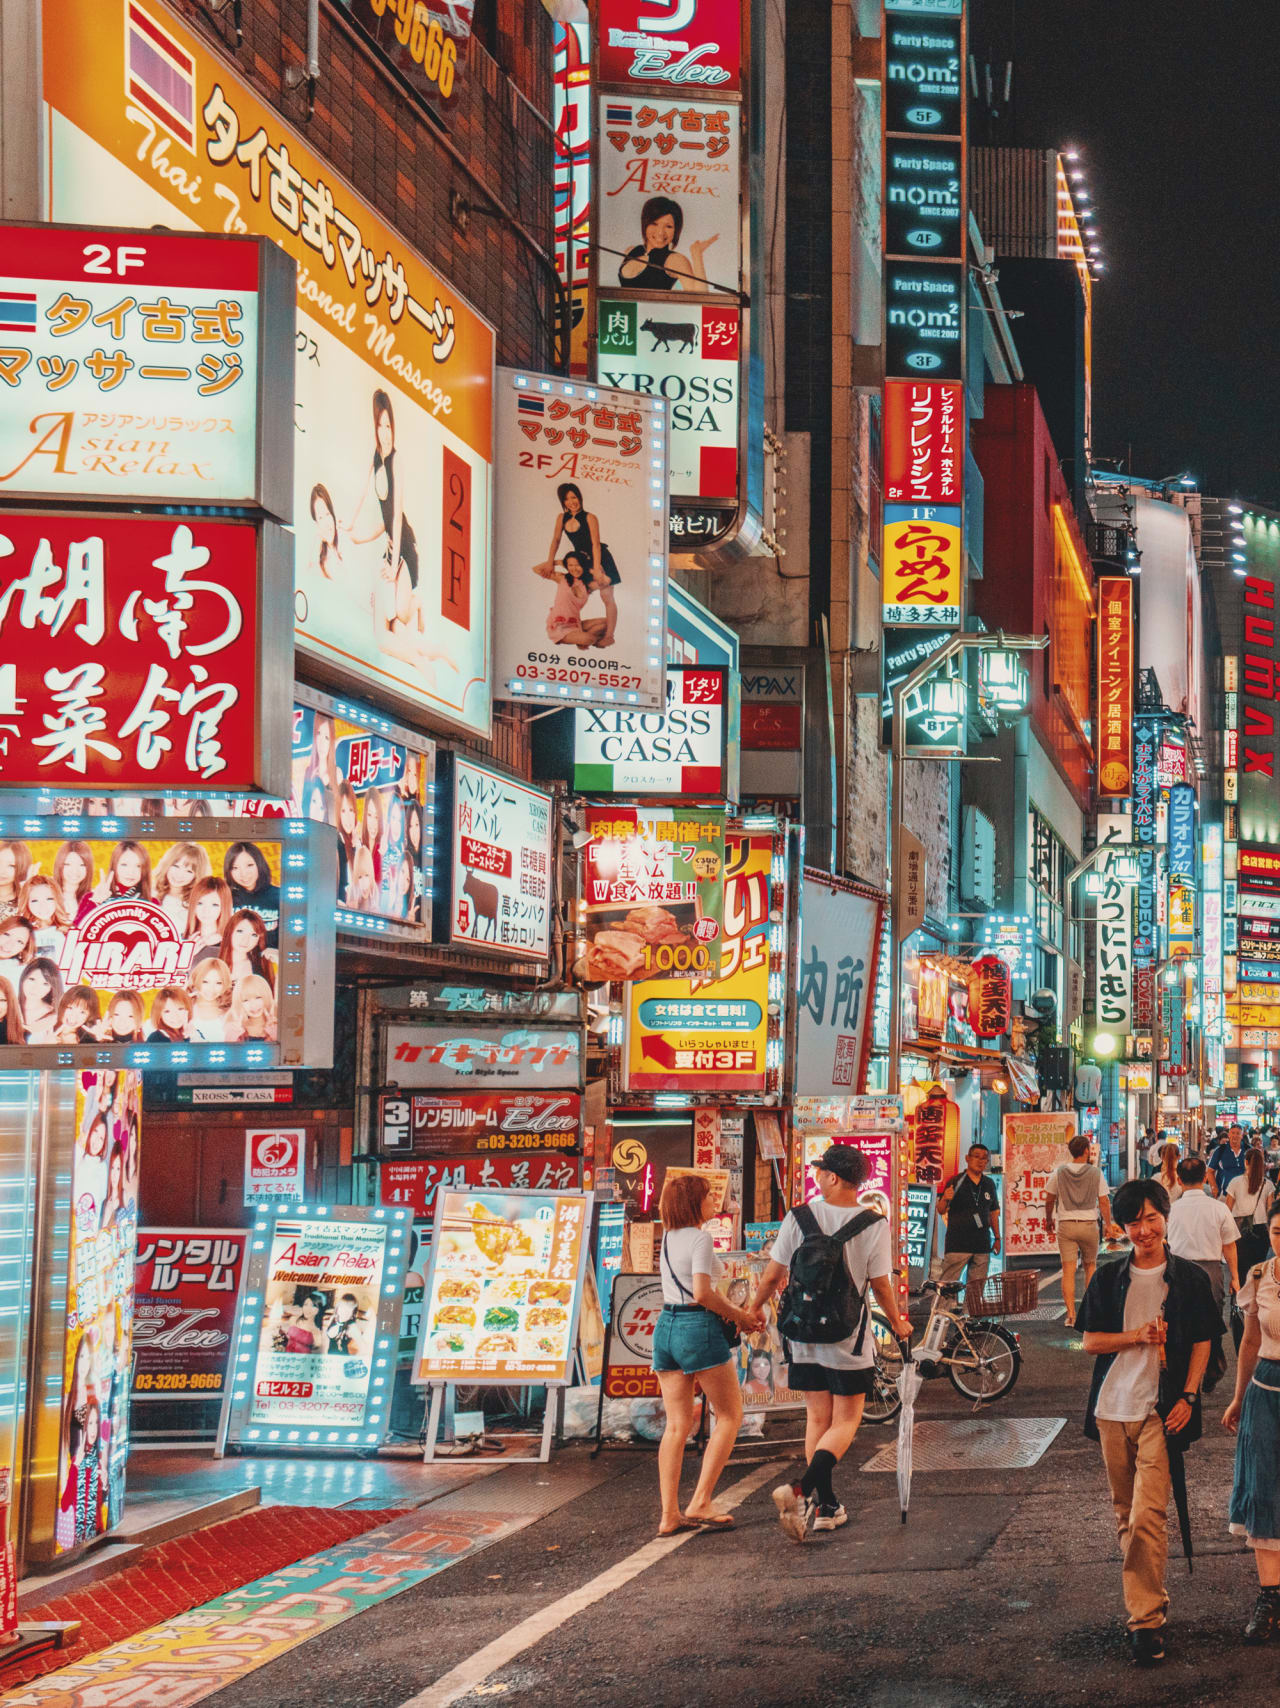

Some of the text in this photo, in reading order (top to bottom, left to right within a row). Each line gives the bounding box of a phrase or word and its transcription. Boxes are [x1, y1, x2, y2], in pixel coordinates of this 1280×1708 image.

[627, 42, 732, 85] Eden
[636, 105, 731, 135] タイ古式
[915, 110, 933, 122] 5F
[605, 130, 731, 159] マッサージ
[652, 158, 731, 173] アジアンリラックス
[202, 83, 457, 362] タイ古式マッサージ
[915, 232, 933, 245] 4F
[82, 243, 147, 277] 2F
[124, 104, 453, 416] Thai Massage
[45, 292, 244, 349] タイ古式
[606, 309, 630, 334] 肉
[703, 319, 739, 335] イタリ
[601, 334, 635, 348] バル
[706, 334, 734, 348] アン
[0, 346, 244, 397] マッサージ
[915, 354, 933, 368] 3F
[81, 411, 237, 435] アジアンリラックス
[546, 399, 643, 436] タイ古式
[517, 419, 643, 457] マッサージ
[910, 386, 934, 500] リフレッシュ
[940, 386, 955, 497] レンタルルーム ホステル
[82, 453, 215, 481] Relax
[518, 451, 553, 470] 2F
[887, 486, 904, 499] 2F
[911, 506, 937, 520] 1F
[446, 471, 467, 609] 2F
[885, 604, 960, 624] 博多天神
[526, 651, 562, 667] 60分
[515, 664, 643, 691] 03-3207-5527
[684, 676, 721, 692] イタリ
[1107, 600, 1123, 751] 個室ダイニング居酒屋
[689, 690, 716, 703] アン
[583, 707, 712, 735] XROSS
[599, 735, 700, 764] CASA
[458, 773, 517, 808] ヘルシー
[458, 800, 502, 842] 肉バル
[589, 820, 722, 844] 肉祭り開催中
[1172, 786, 1192, 859] カラオケ
[1171, 860, 1191, 872] 747
[85, 904, 152, 942] community
[500, 920, 545, 948] 低カロリー
[1100, 825, 1129, 1025] とんかつにいむら
[674, 1050, 755, 1070] 受付3F
[193, 1092, 275, 1101] XROSS CASA
[413, 1107, 499, 1130] レンタルルーム
[499, 1097, 580, 1134] Eden
[487, 1132, 577, 1151] 03-3203-9666
[251, 1167, 298, 1178] 防犯カメラ
[251, 1182, 297, 1194] すてるな
[387, 1186, 415, 1203] 4F
[275, 1242, 382, 1270] Asian Relax
[151, 1264, 236, 1293] ルーム
[272, 1270, 367, 1285] Welcome Foreigner
[133, 1308, 233, 1350] Eden
[135, 1373, 223, 1390] 03-3203-9666
[277, 1401, 364, 1413] 03-3207-5527
